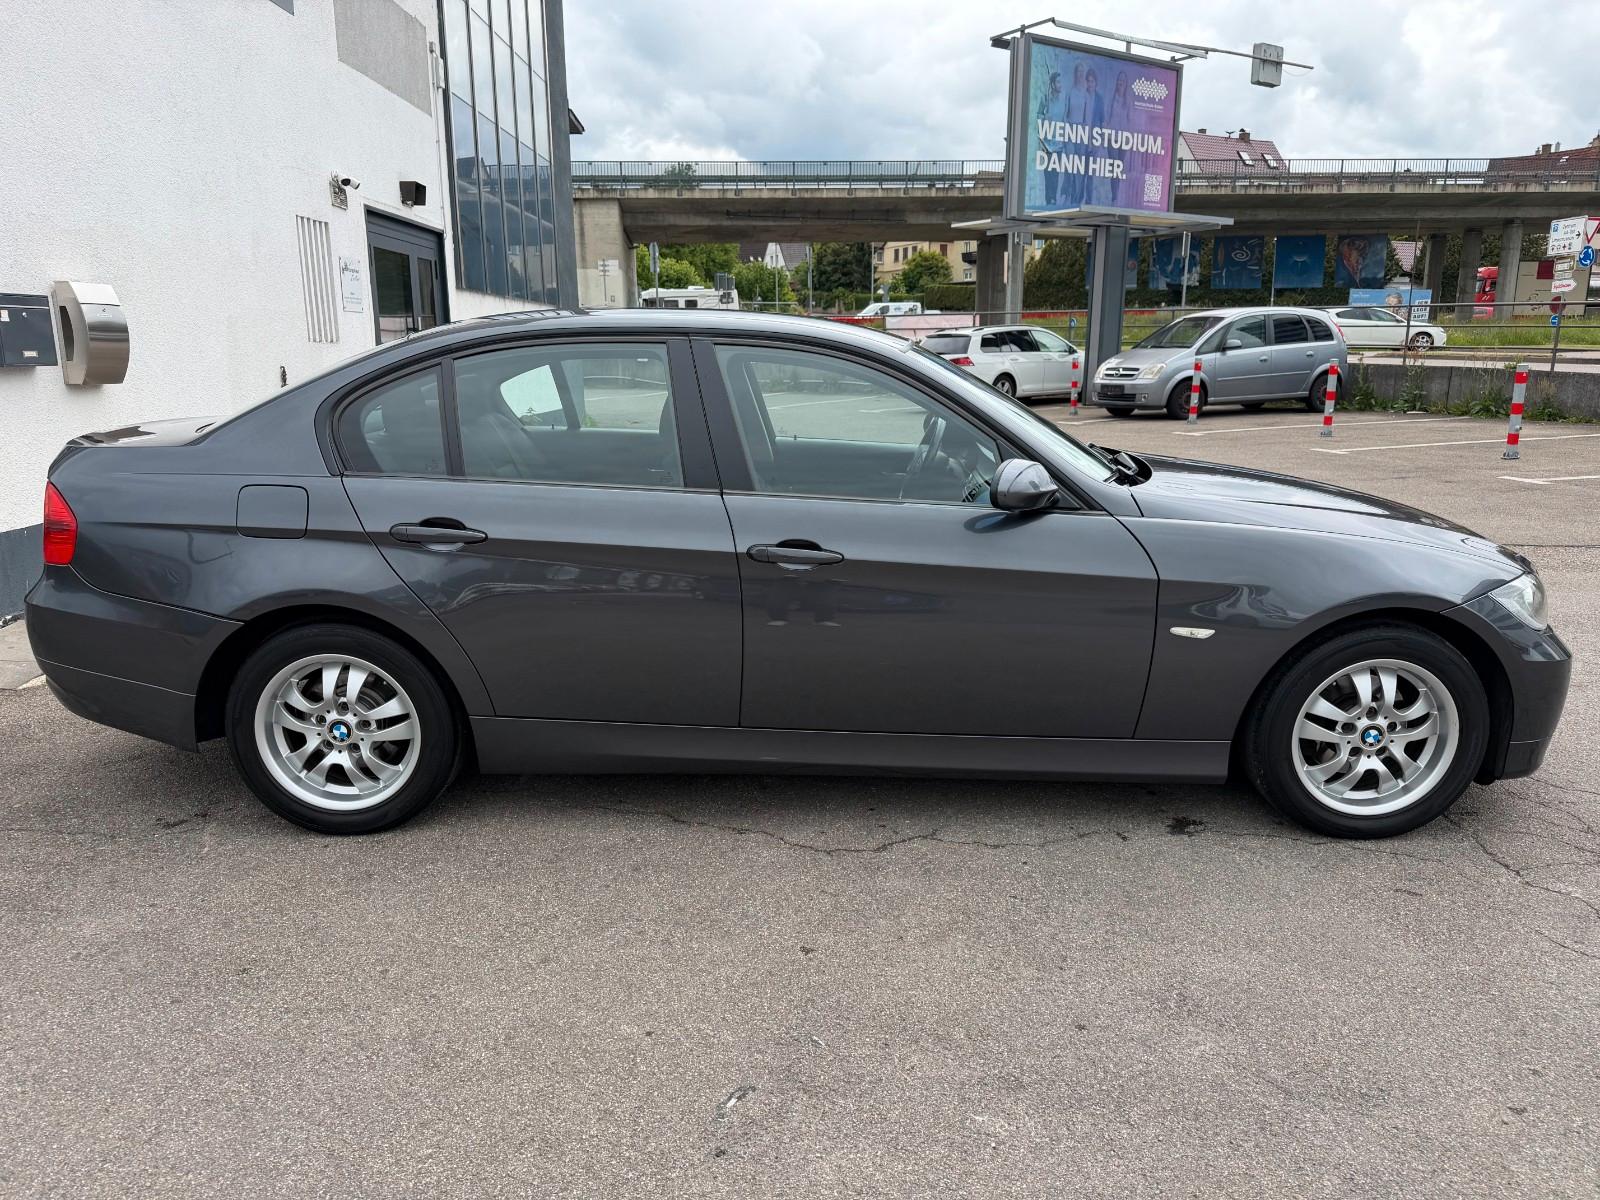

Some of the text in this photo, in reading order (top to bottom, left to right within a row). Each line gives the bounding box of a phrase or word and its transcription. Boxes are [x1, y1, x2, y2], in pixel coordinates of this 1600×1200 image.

[1037, 119, 1165, 155] WENN STUDIUM.
[1035, 150, 1126, 180] DANN HIER.
